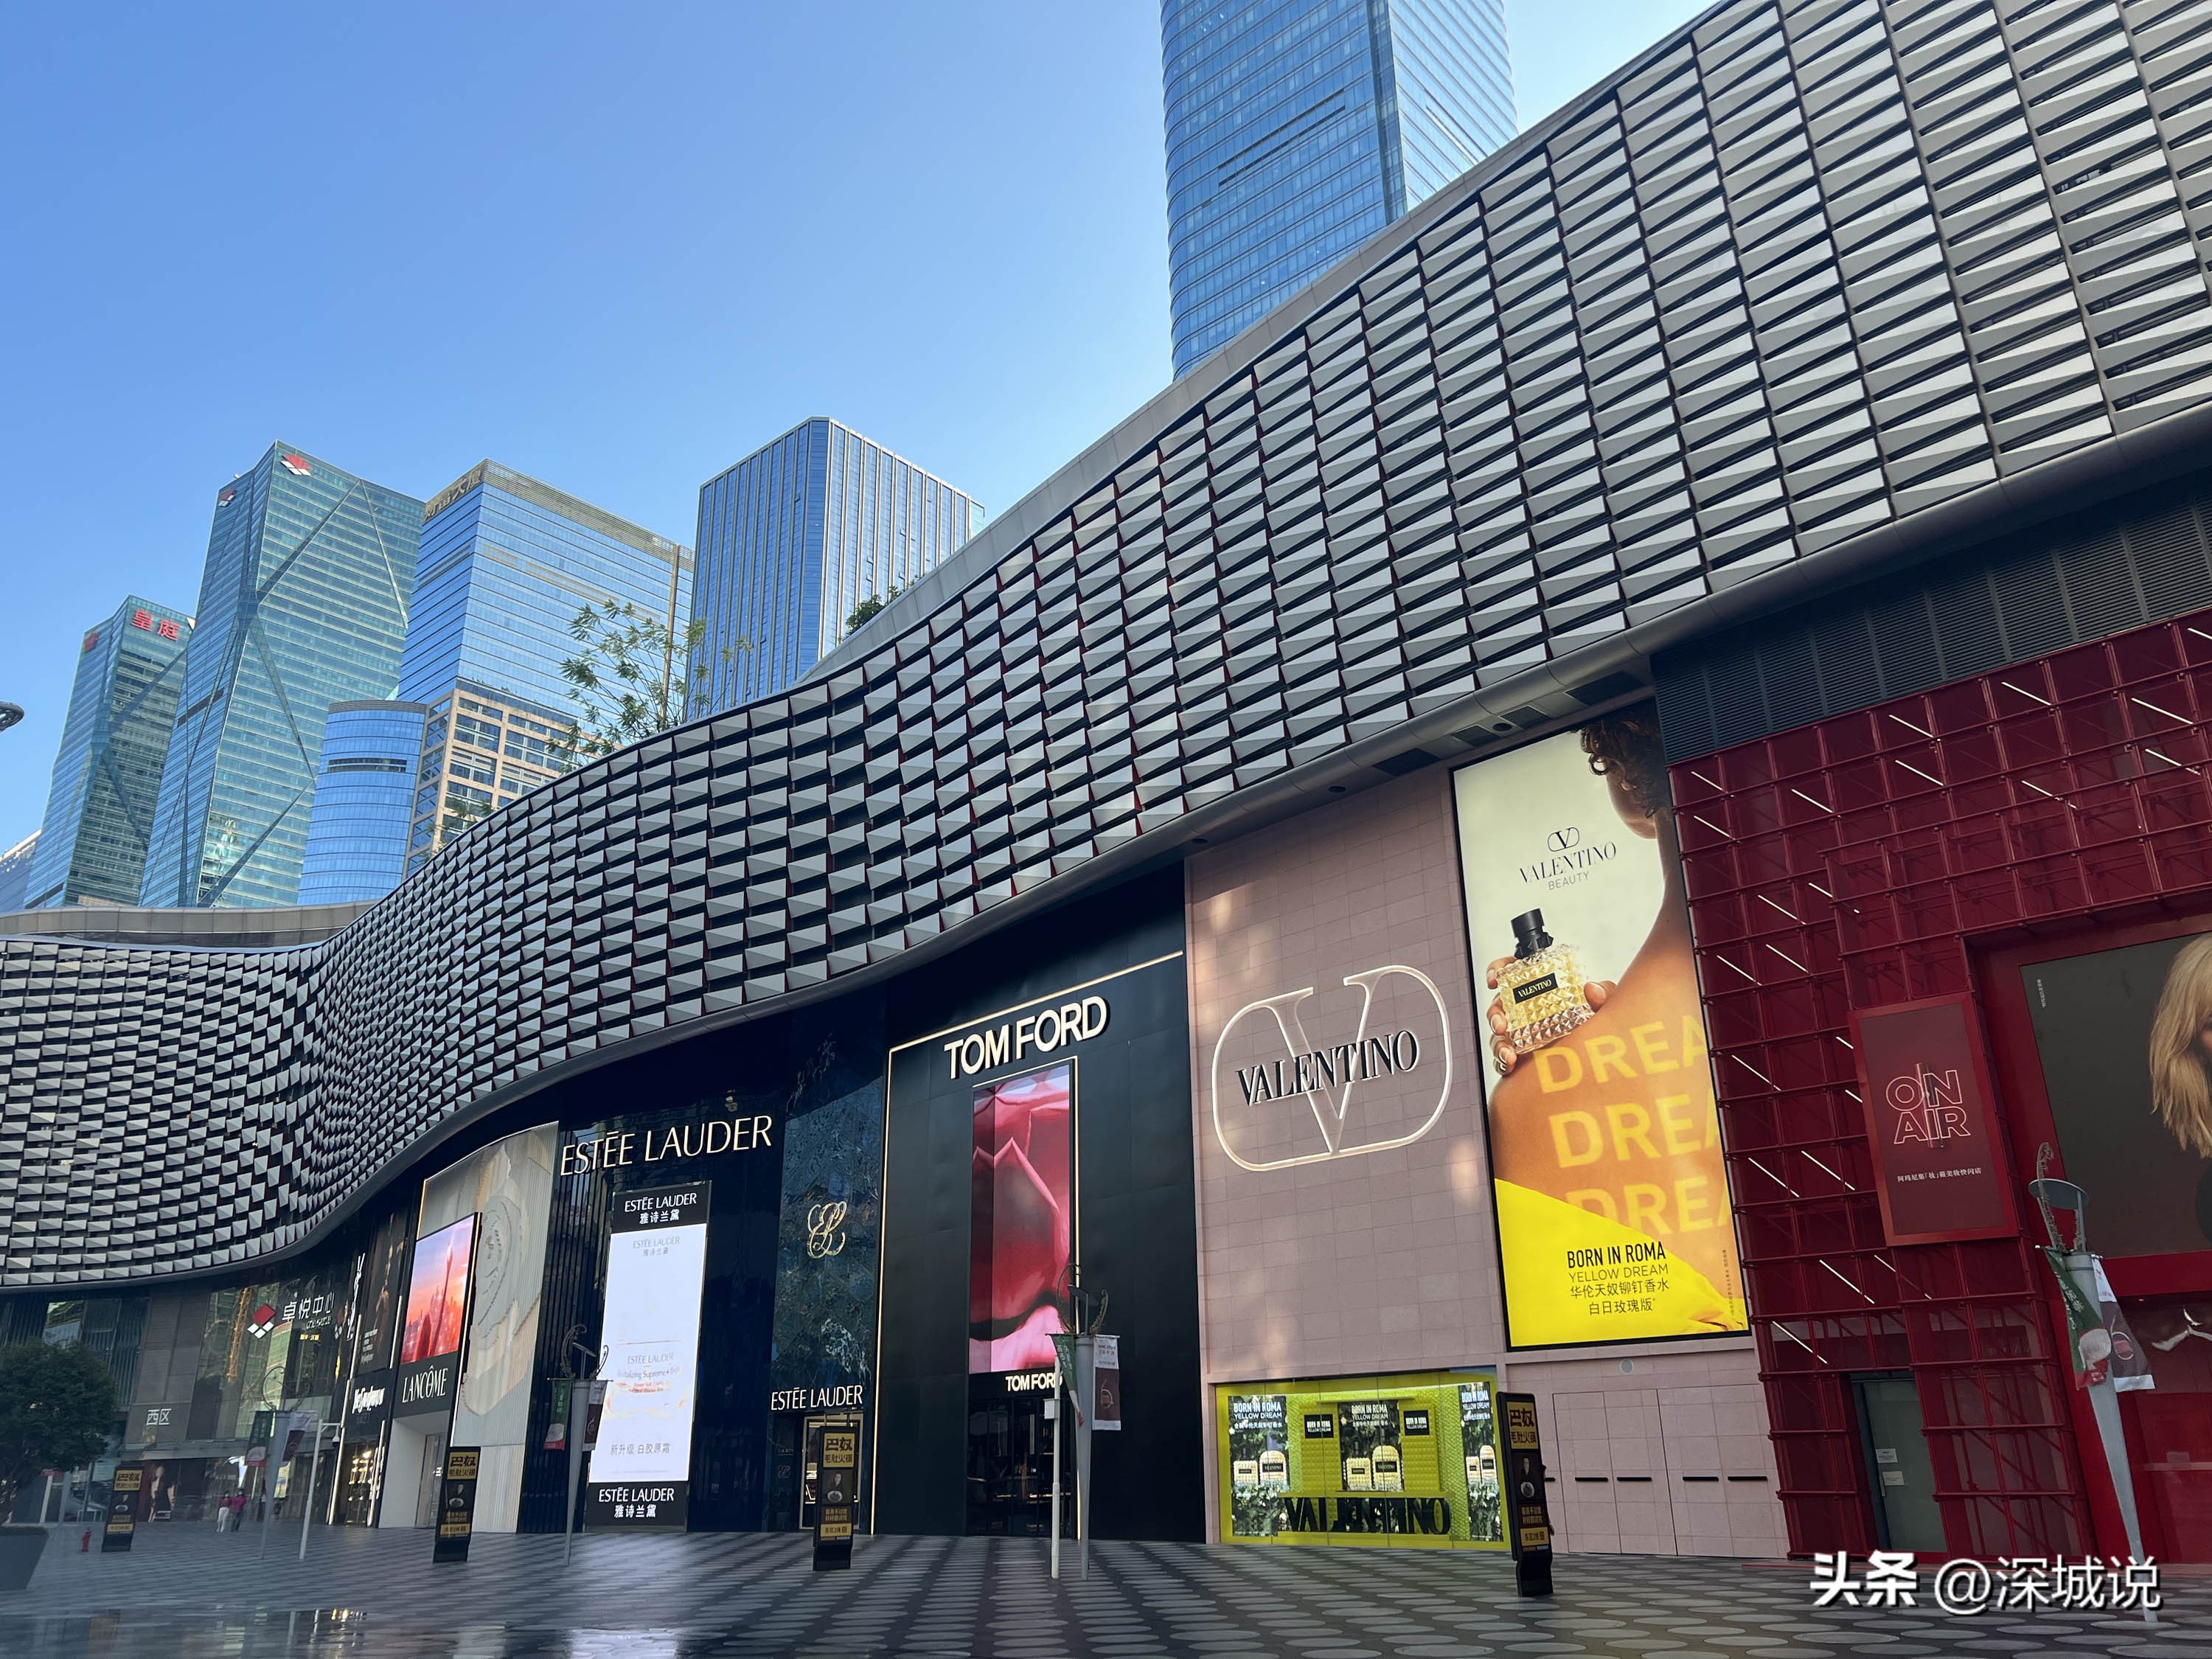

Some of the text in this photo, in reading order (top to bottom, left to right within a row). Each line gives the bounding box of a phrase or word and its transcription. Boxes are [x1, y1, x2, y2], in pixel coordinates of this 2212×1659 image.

[131, 608, 181, 642] 皇庭
[1519, 841, 1616, 883] VALENTINO
[1548, 871, 1589, 891] BEAUTY
[1517, 978, 1552, 998] VALENTINO
[944, 995, 1107, 1079] TOM FORD
[1235, 1029, 1419, 1107] VALENTINO
[1885, 1069, 1963, 1112] ON
[1893, 1105, 1971, 1144] AIR
[644, 1115, 773, 1162] LAUDER
[655, 1192, 697, 1209] LAUDER
[639, 1208, 680, 1225] 雅诗兰黛
[1567, 1241, 1666, 1269] BORN IN ROMA
[1568, 1264, 1669, 1283] YELLOW DREAM
[1571, 1277, 1669, 1299] 华伦天奴铆钉香水
[402, 1365, 448, 1403] LANCÔME
[1005, 1374, 1030, 1392] TOM
[810, 1385, 863, 1408] LAUDER
[147, 1408, 172, 1425] 西区
[1234, 1402, 1251, 1413] BORN
[1262, 1401, 1281, 1412] ROMA
[1509, 1408, 1534, 1428] 巴奴
[825, 1436, 853, 1452] 巴奴
[450, 1455, 476, 1467] 巴奴
[631, 1488, 675, 1503] LAUDER
[614, 1503, 656, 1518] 雅诗兰黛
[1284, 1498, 1452, 1534] VALENTINO
